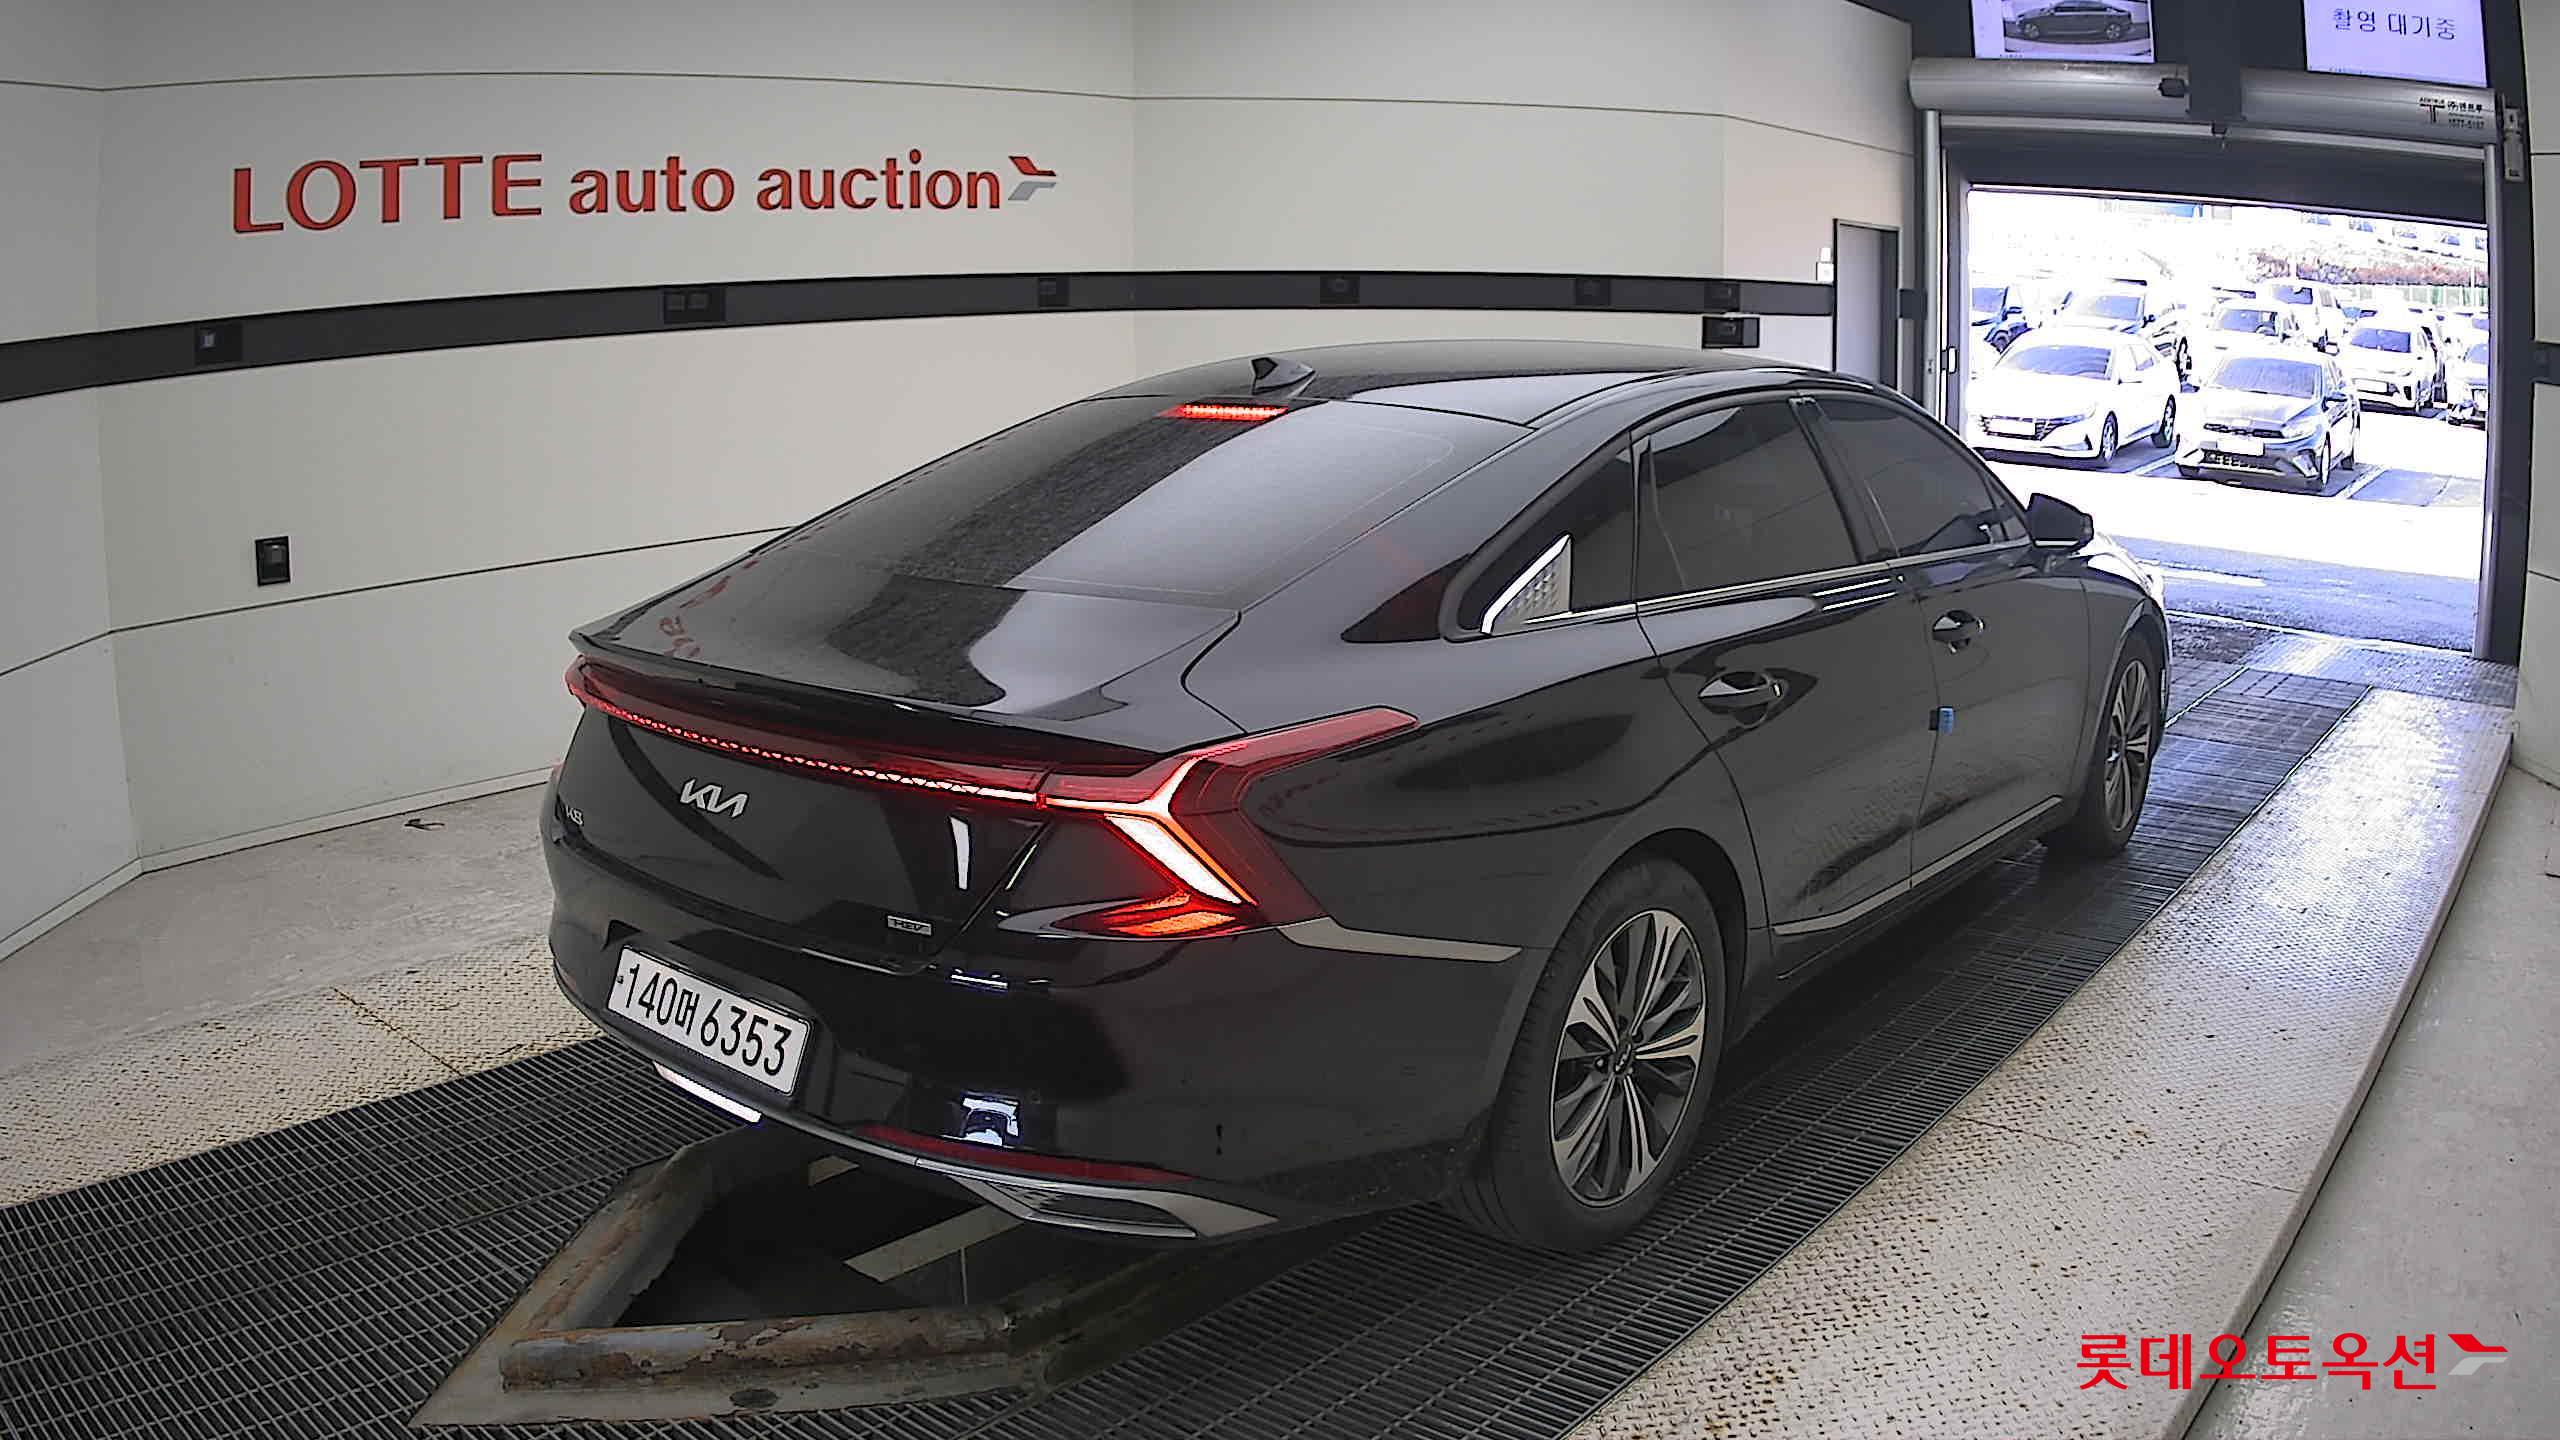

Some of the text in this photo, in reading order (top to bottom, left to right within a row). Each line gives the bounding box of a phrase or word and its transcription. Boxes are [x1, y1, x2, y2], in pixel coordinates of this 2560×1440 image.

[2333, 9, 2457, 41] 촬영 대기중
[232, 149, 1002, 234] LOTTE auto auction
[565, 804, 584, 825] K8
[680, 778, 748, 817] KIA
